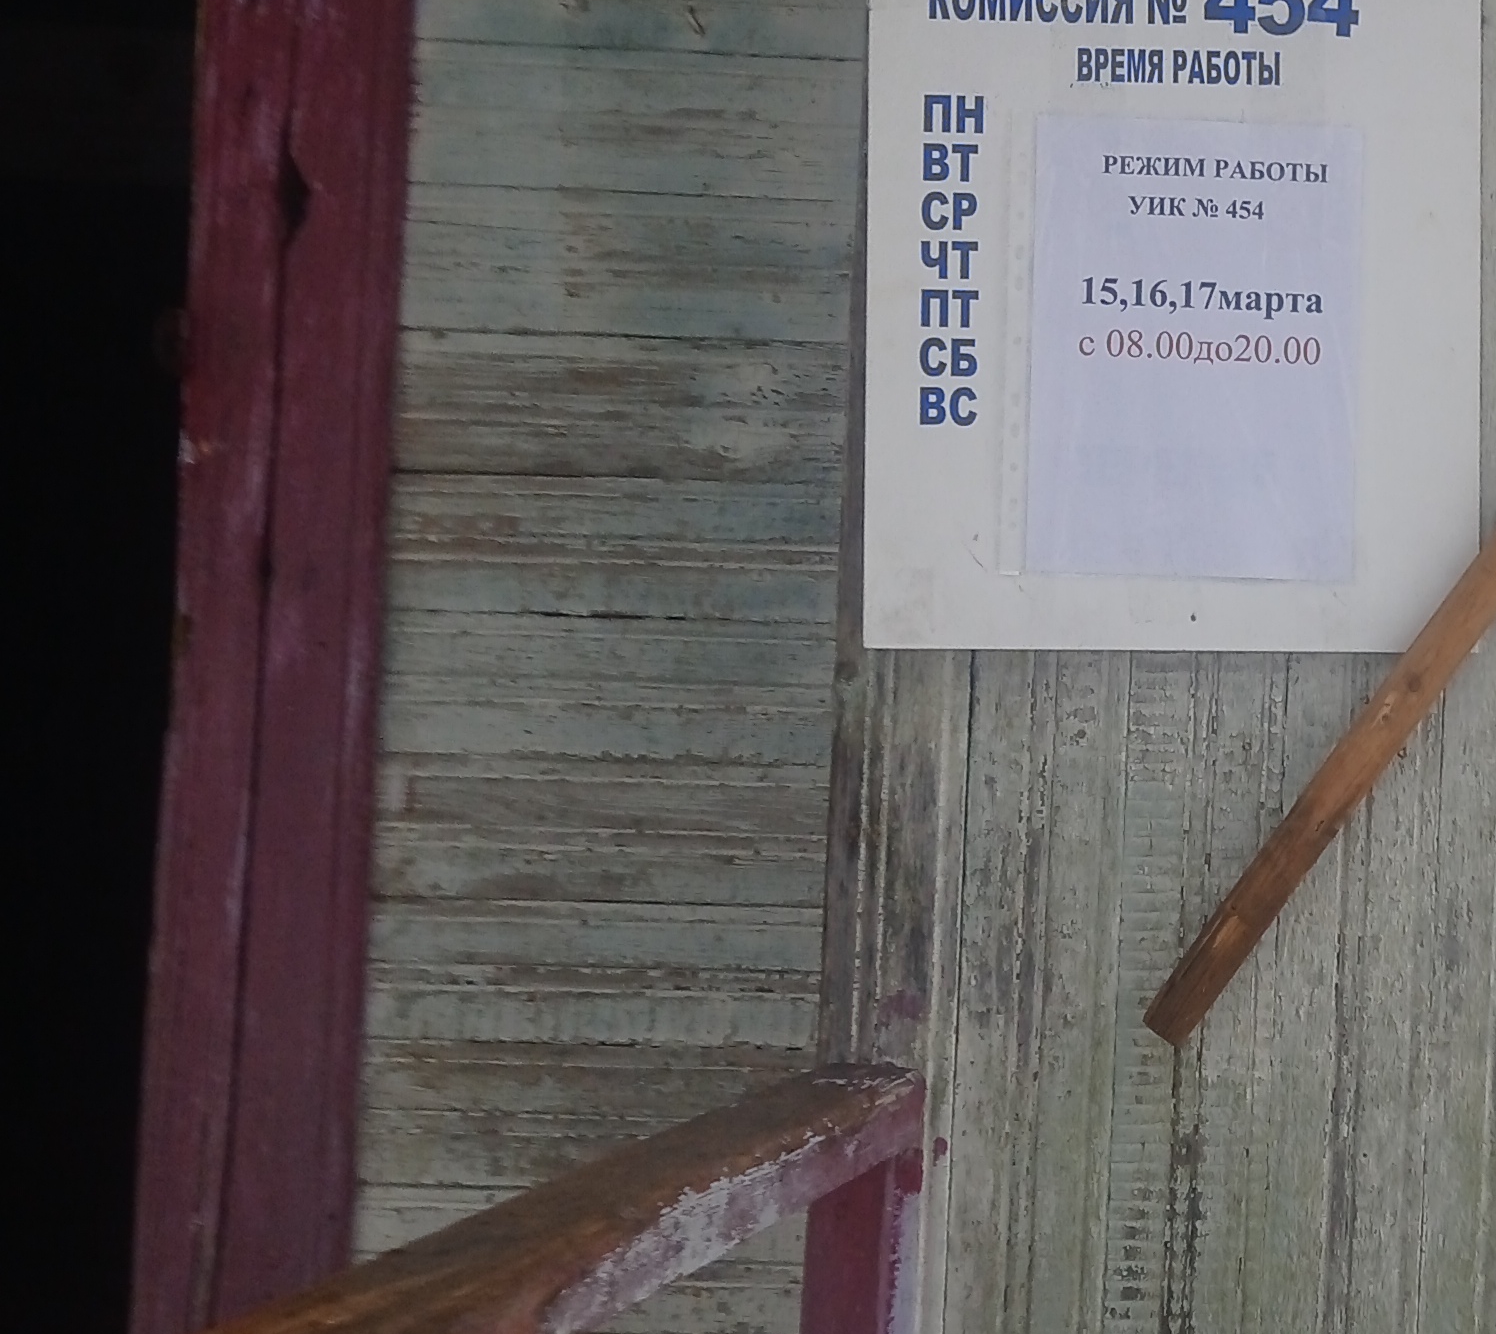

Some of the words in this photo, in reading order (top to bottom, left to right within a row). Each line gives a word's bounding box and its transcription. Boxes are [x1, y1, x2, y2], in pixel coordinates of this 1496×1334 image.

[1076, 47, 1164, 84] ВРЕМЯ
[1172, 49, 1281, 87] РАБОТЫ
[923, 94, 985, 134] ПН
[922, 143, 979, 182] ВТ
[1102, 154, 1206, 179] РЕЖИМ
[1213, 158, 1329, 184] РАБОТЫ
[921, 192, 977, 231] СР
[1128, 195, 1187, 219] УИК
[1192, 197, 1219, 220] №
[1225, 198, 1266, 221] 454
[920, 240, 979, 280] ЧТ
[920, 289, 979, 329] ПТ
[1081, 276, 1324, 321] 15,16,17марта
[919, 338, 978, 377] СБ
[1078, 335, 1096, 358] с
[1105, 328, 1322, 366] 08.00до20.00
[919, 386, 978, 427] ВС
